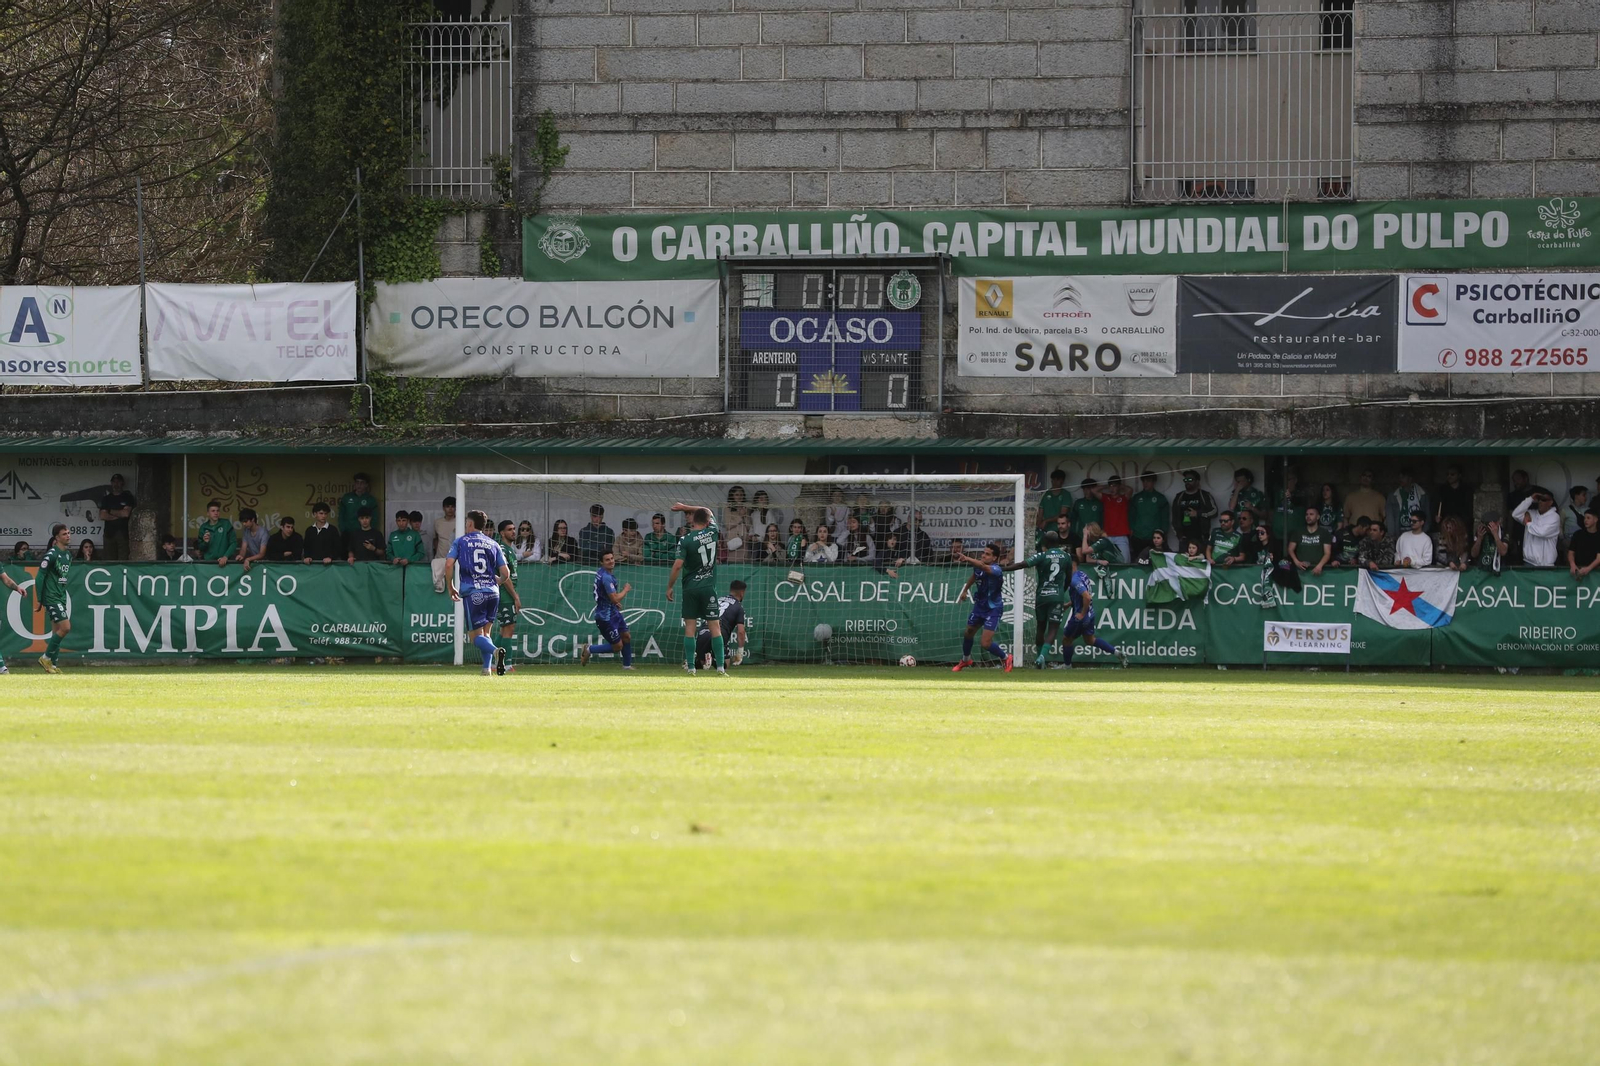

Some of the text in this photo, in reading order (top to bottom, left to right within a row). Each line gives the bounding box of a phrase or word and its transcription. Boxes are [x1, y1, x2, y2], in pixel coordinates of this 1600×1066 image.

[612, 227, 638, 262] O
[923, 220, 1087, 257] CAPITAL
[1101, 216, 1289, 255] MUNDIAL
[1303, 214, 1358, 251] DO
[1373, 210, 1510, 250] PULPO
[1553, 229, 1565, 239] do
[153, 299, 349, 342] AVATEL
[411, 299, 675, 330] ORECO BALGÓN
[769, 317, 894, 344] OCASO
[969, 326, 1088, 337] Pol. Ind. de Uceira, parcela B-3
[1101, 325, 1165, 335] O CARBALLIÑO
[1253, 333, 1382, 344] restaurante-bar
[276, 345, 349, 359] TELECOM
[462, 345, 622, 356] CONSTRUCTORA
[1247, 352, 1271, 360] Pedazo
[1272, 352, 1281, 360] de
[1281, 352, 1303, 360] Galicia
[1313, 352, 1337, 360] Madrid
[752, 352, 797, 364] ARENTEIRO
[1014, 342, 1122, 372] SARO
[1464, 347, 1589, 367] 988 272565
[78, 458, 89, 467] en
[91, 457, 100, 467] tu
[101, 456, 133, 467] destino
[902, 505, 963, 516] PEGADO
[966, 505, 985, 516] DE
[988, 505, 1015, 516] CHA
[919, 518, 978, 528] LUMINIO
[989, 518, 1015, 528] INO
[70, 525, 102, 535] 988 27
[697, 541, 717, 567] 17
[473, 548, 487, 574] 5
[1048, 562, 1061, 581] 2
[84, 567, 298, 597] Gimnasio
[774, 580, 975, 604] CASAL DE PAULA
[1303, 584, 1335, 606] DE
[1534, 586, 1567, 608] DE
[410, 613, 455, 628] PULPE
[845, 619, 898, 632] RIBEIRO
[311, 621, 387, 633] O CARBALLIÑO
[1519, 626, 1577, 640] RIBEIRO
[609, 628, 620, 639] 23
[1282, 627, 1348, 641] VERSUS
[309, 636, 388, 646] Teléf. 988 27 10 14
[896, 635, 919, 645] ORIXE
[1289, 641, 1343, 649] E-LEARNING
[1350, 641, 1366, 649] RIXE
[1496, 642, 1600, 651] DENOMINACIÓN DE ORIXE
